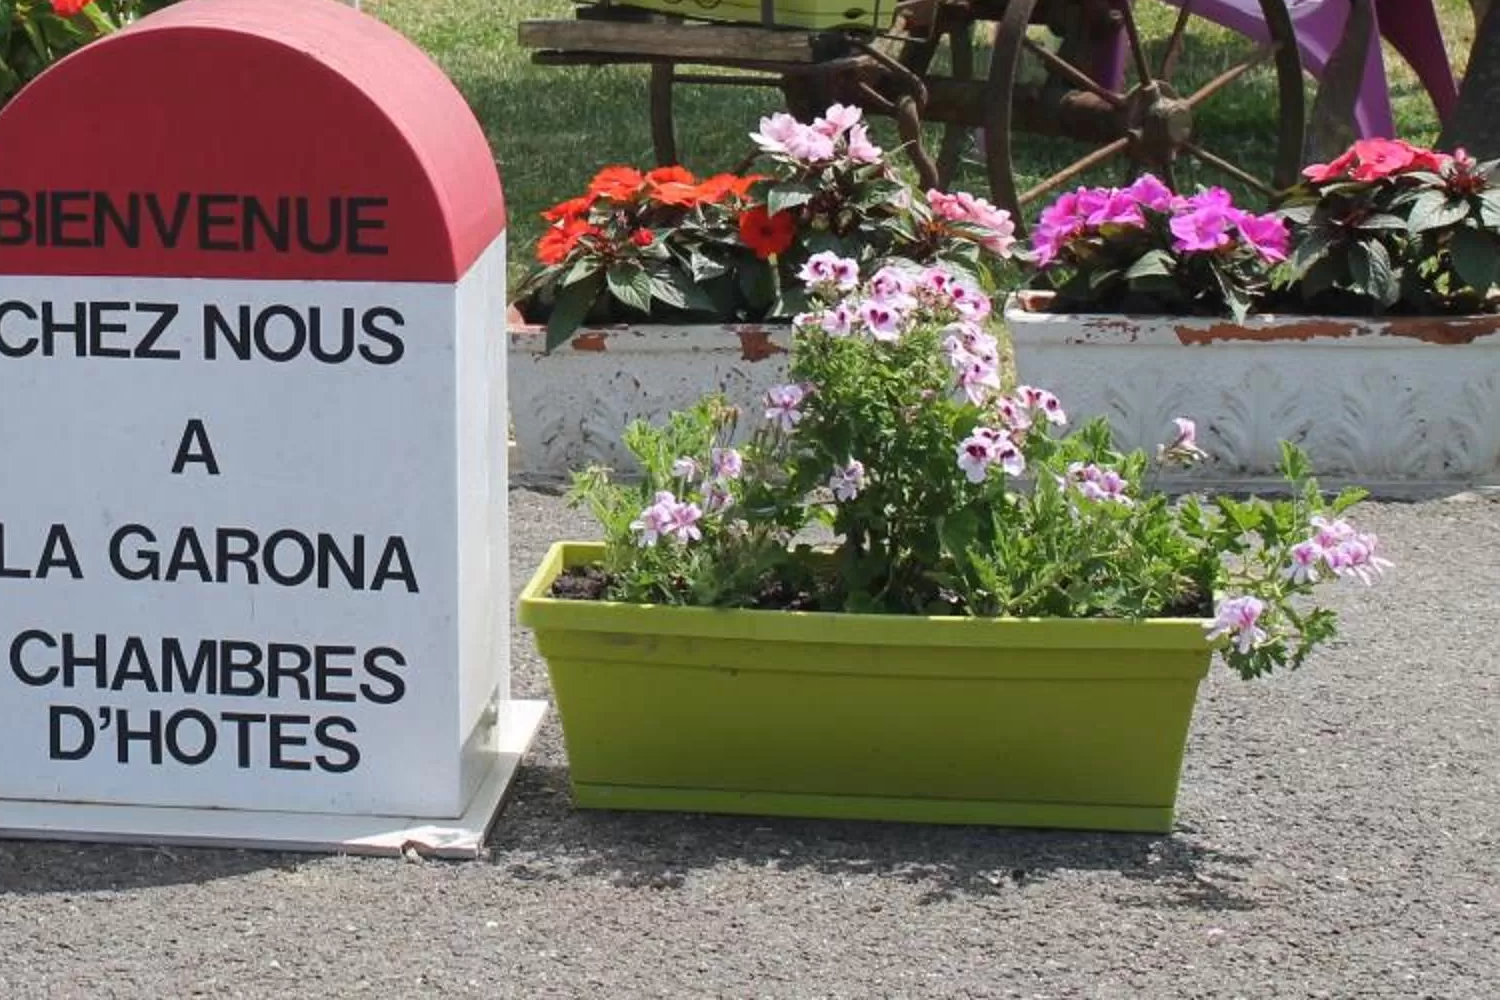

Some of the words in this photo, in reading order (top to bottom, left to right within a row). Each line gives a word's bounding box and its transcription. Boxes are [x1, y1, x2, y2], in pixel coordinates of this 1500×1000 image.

[203, 304, 405, 365] NOUS
[171, 418, 221, 475] A
[109, 523, 420, 593] GARONA
[9, 629, 406, 705] CHAMBRES
[49, 705, 361, 774] D'HOTES
